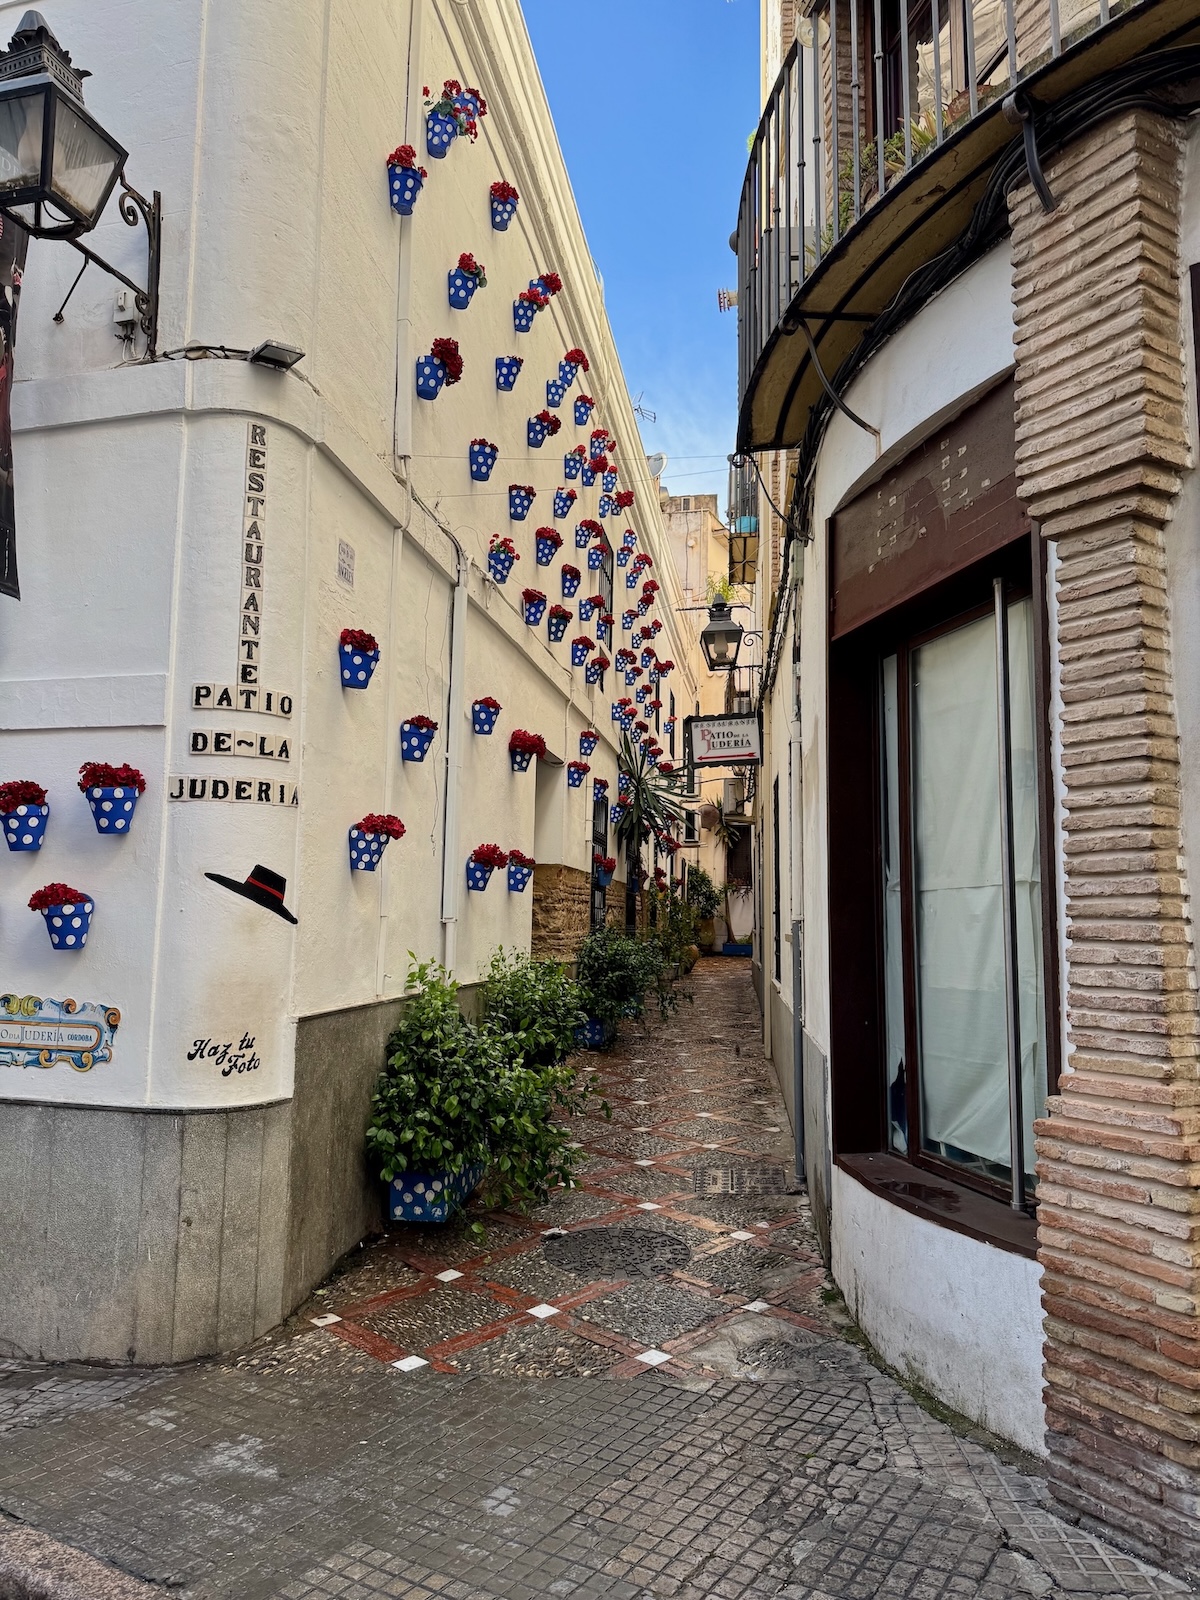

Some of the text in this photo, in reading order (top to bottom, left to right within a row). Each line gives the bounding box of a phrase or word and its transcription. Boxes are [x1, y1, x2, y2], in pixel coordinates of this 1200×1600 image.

[241, 424, 266, 684] RESTAURANTE
[195, 686, 292, 715] PATIO
[693, 719, 757, 729] RESTAURANTE
[700, 729, 734, 741] PATIO
[705, 738, 752, 755] JUDERÍA
[169, 778, 299, 805] JUDERIA
[187, 1031, 256, 1066] Haz tu
[221, 1052, 261, 1077] Foto
